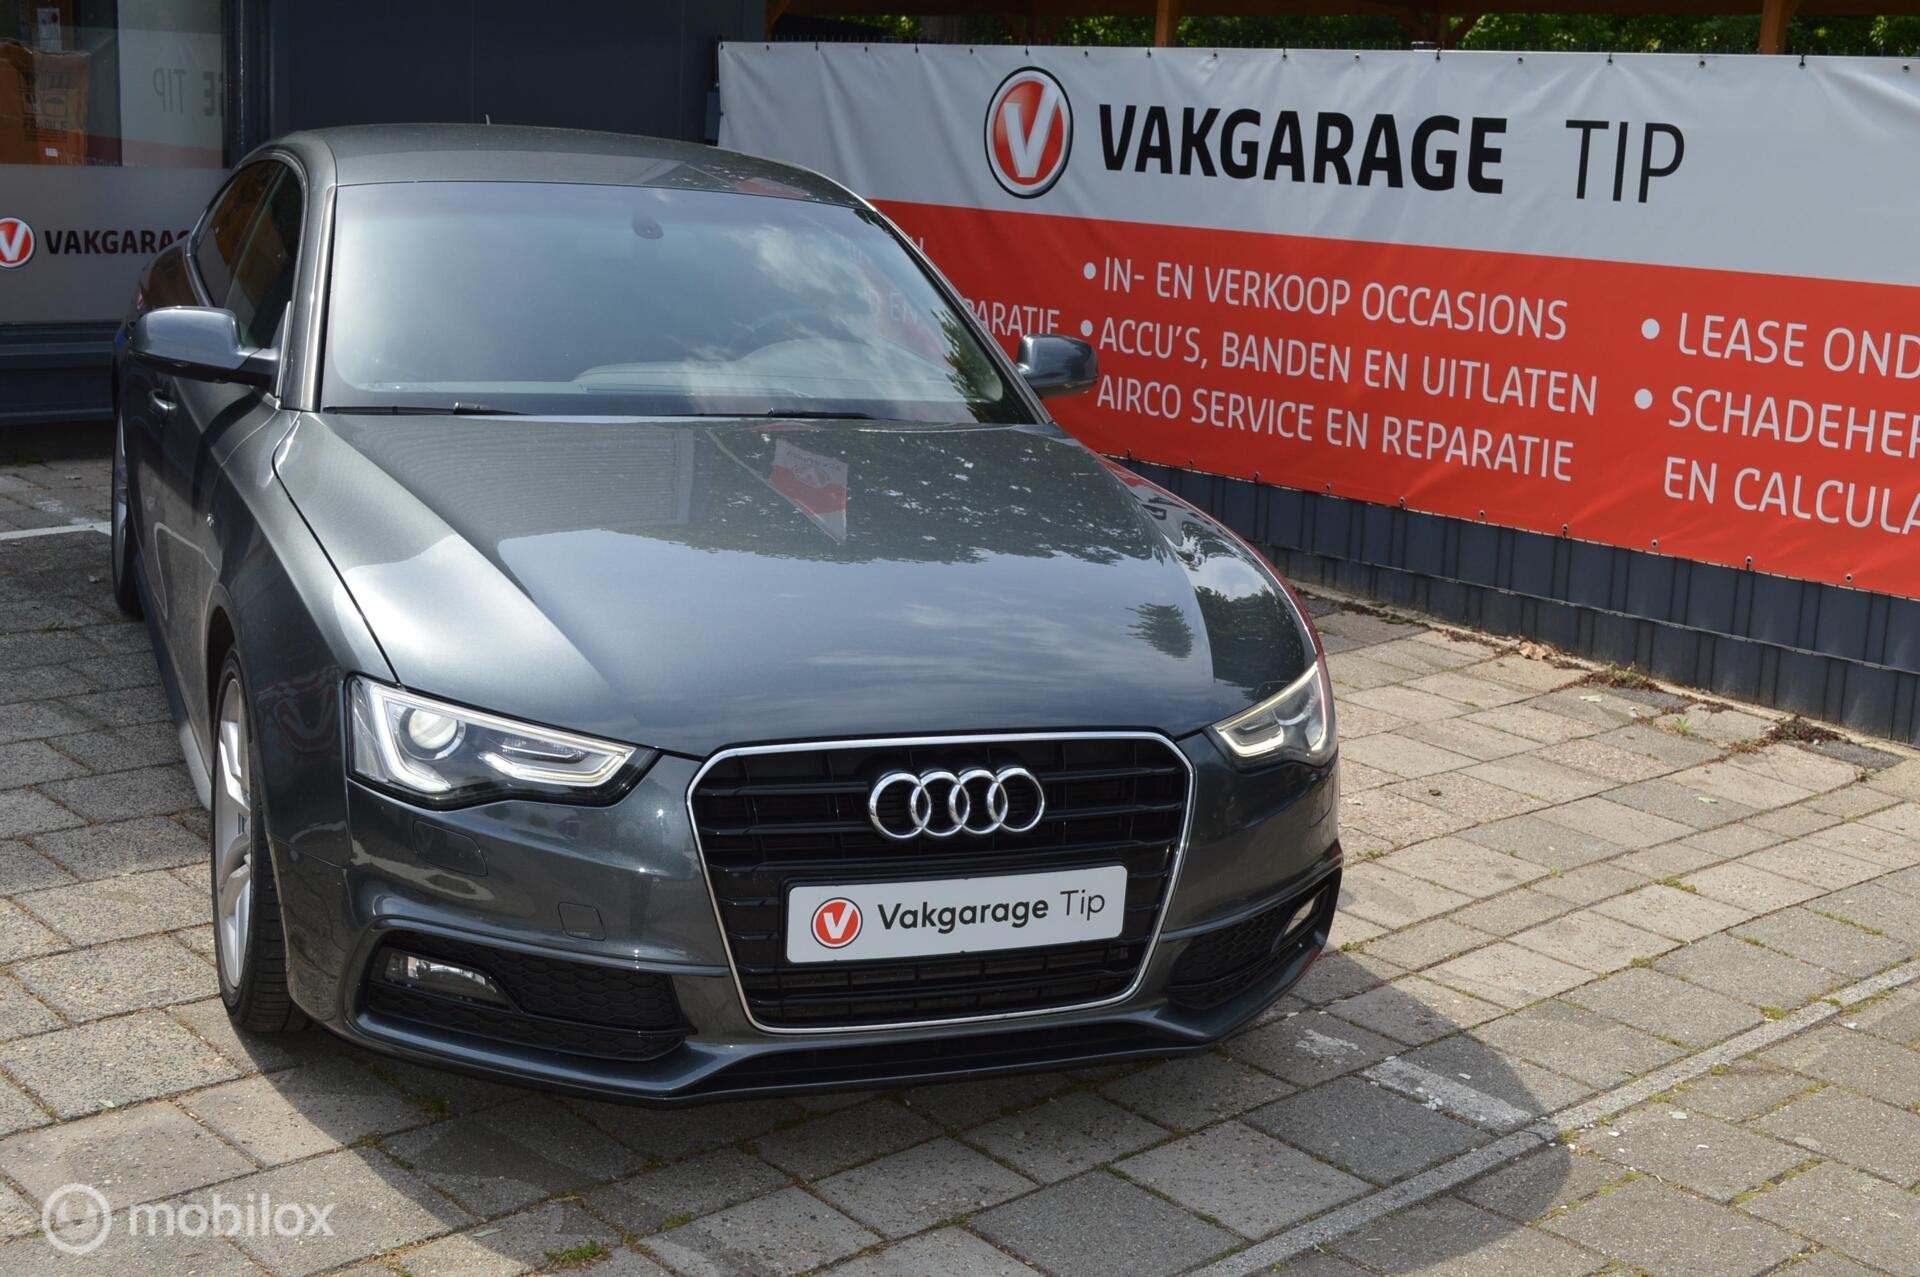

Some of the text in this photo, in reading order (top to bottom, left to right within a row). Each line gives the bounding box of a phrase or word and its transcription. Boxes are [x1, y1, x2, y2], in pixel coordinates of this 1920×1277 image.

[1100, 104, 1507, 194] VAKGARAGE
[1566, 119, 1685, 203] TIP
[1103, 256, 1568, 341] IN- EN VERKOOP OCCASIONS
[1099, 316, 1598, 416] ACCU'S, BANDEN EN UITLATEN
[1678, 312, 1920, 380] LEASE OND
[1096, 374, 1574, 482] AIRCO SERVICE EN REPARATIE
[1664, 456, 1718, 504] EN
[877, 895, 1049, 935] Vakgarage
[1060, 889, 1105, 922] Tip
